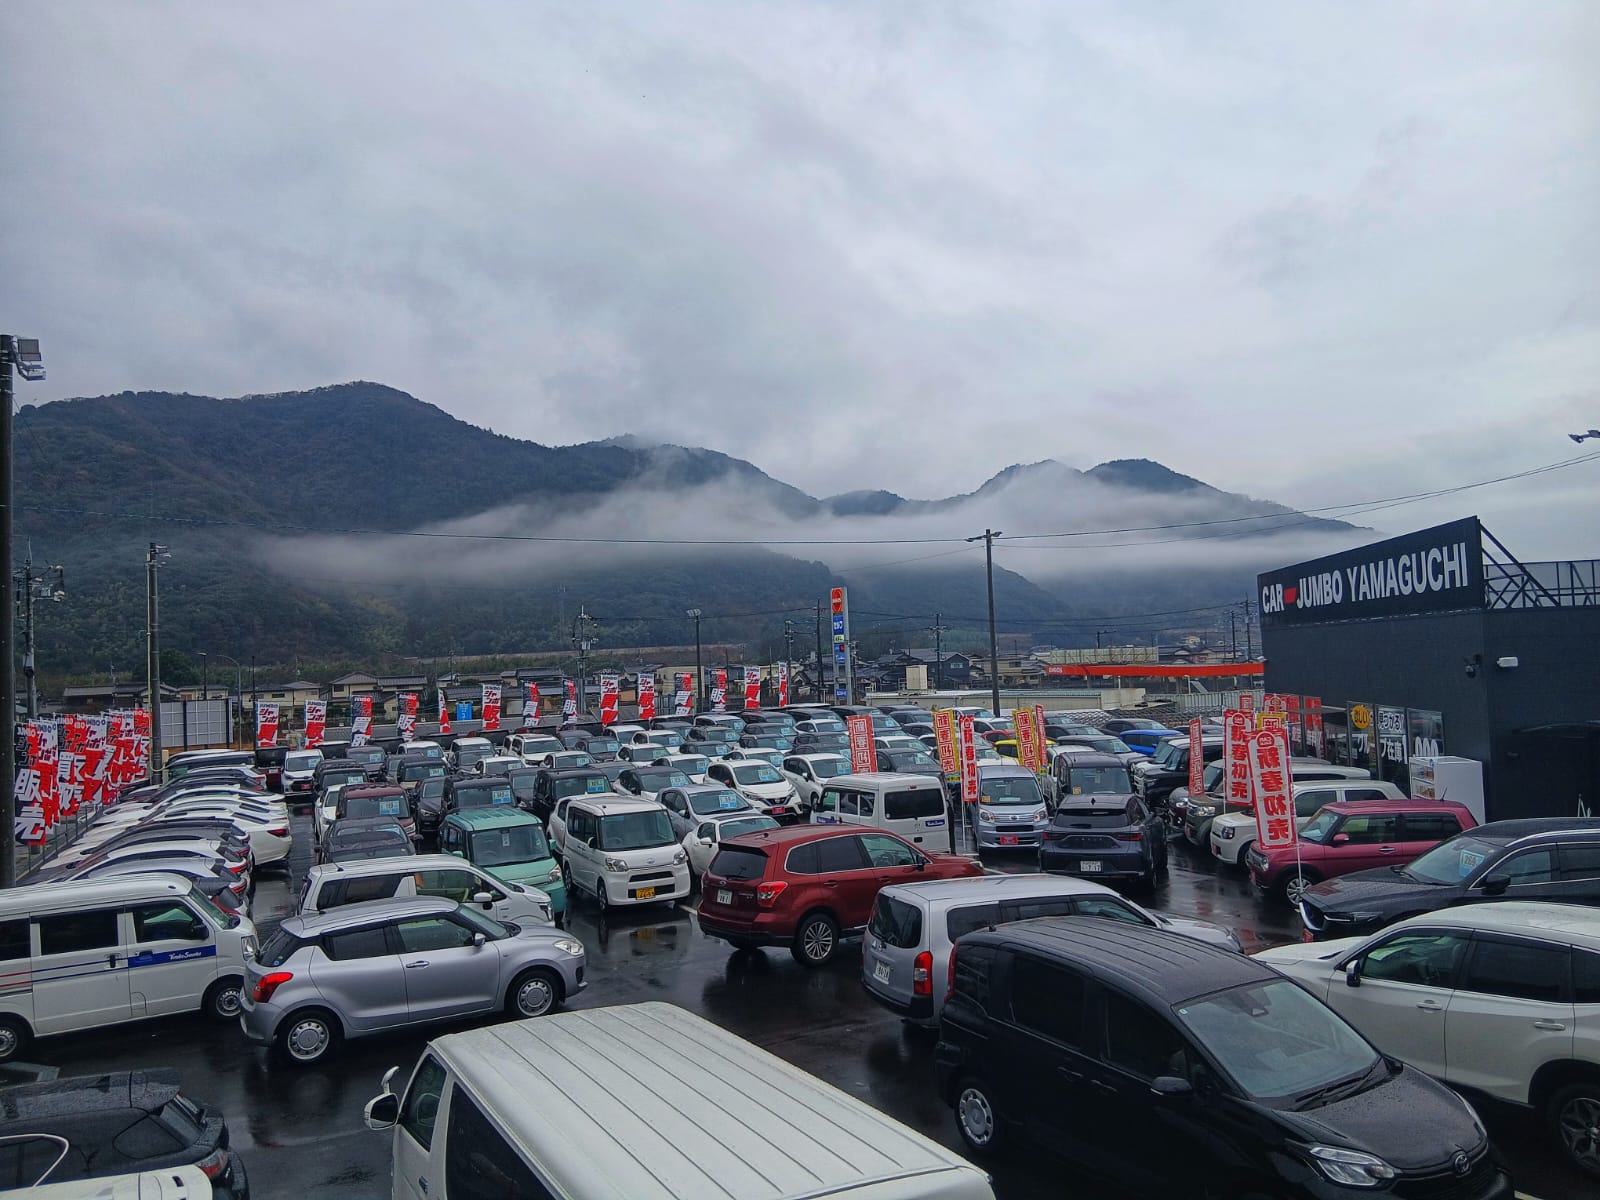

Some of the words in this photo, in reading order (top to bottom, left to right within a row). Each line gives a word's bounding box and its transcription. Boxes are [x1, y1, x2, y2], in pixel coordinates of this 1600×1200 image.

[1262, 583, 1285, 614] CAR
[1296, 569, 1343, 609] JUMBO
[1346, 542, 1469, 602] YAMAGUCHI
